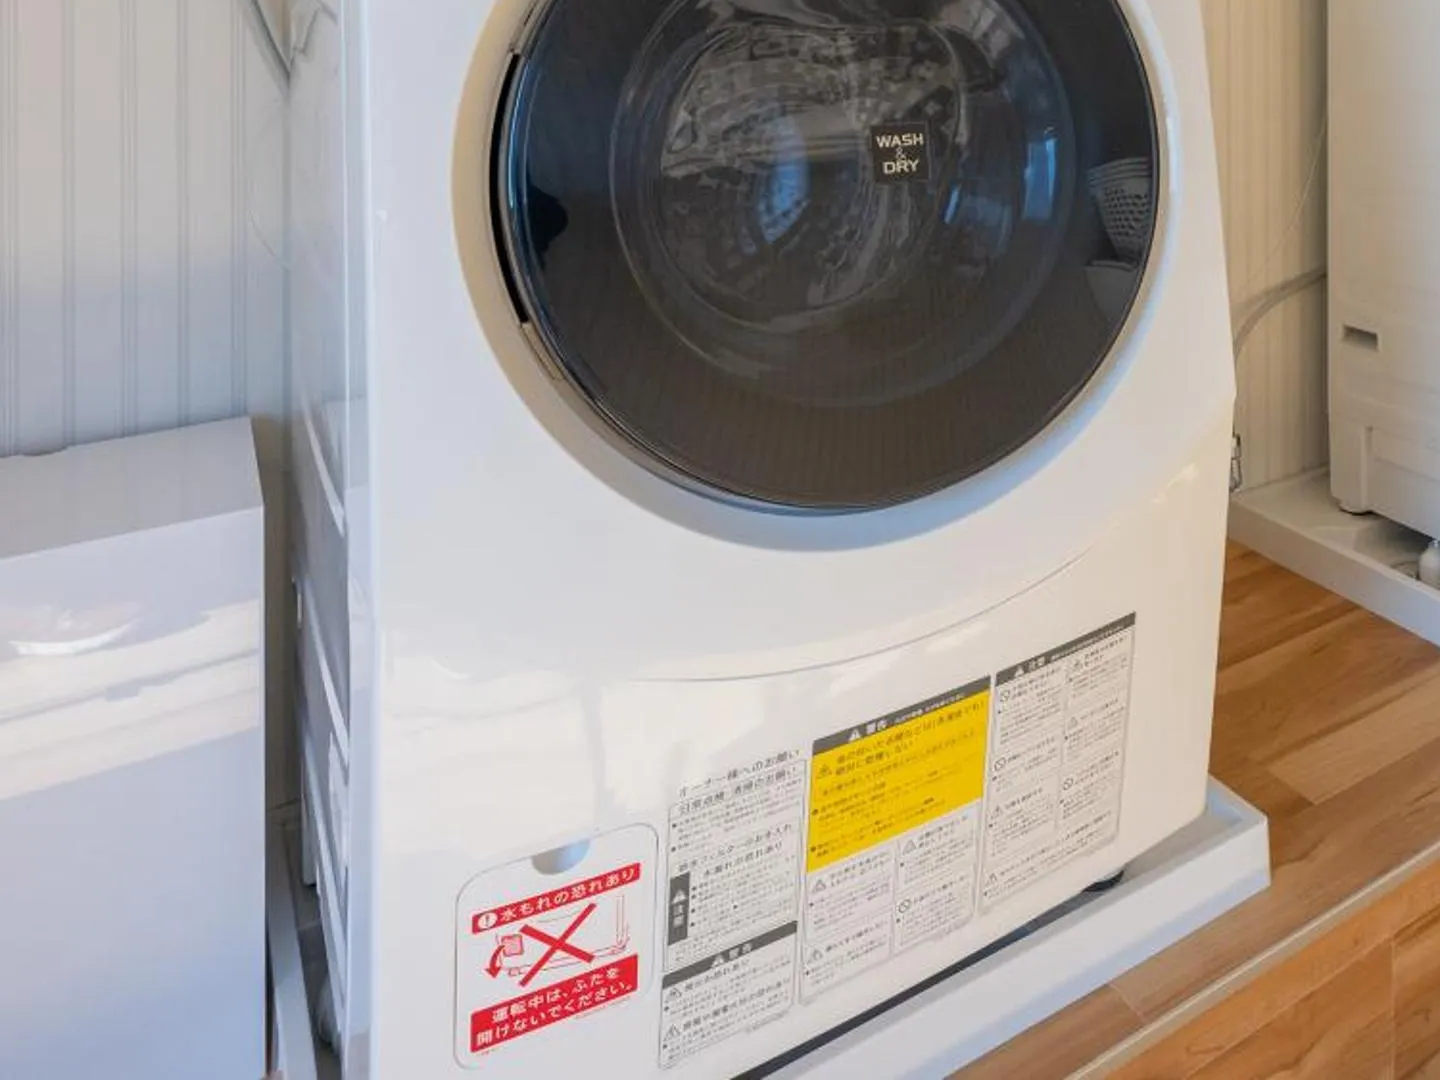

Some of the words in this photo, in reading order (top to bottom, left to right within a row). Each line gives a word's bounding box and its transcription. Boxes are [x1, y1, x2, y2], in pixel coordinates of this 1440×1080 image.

[876, 133, 924, 148] WASH
[883, 159, 919, 175] DRY
[500, 867, 636, 922] 水もれの恐れあり
[475, 982, 633, 1047] 開けないでください。
[491, 966, 621, 1023] 運転中は、ふたを
